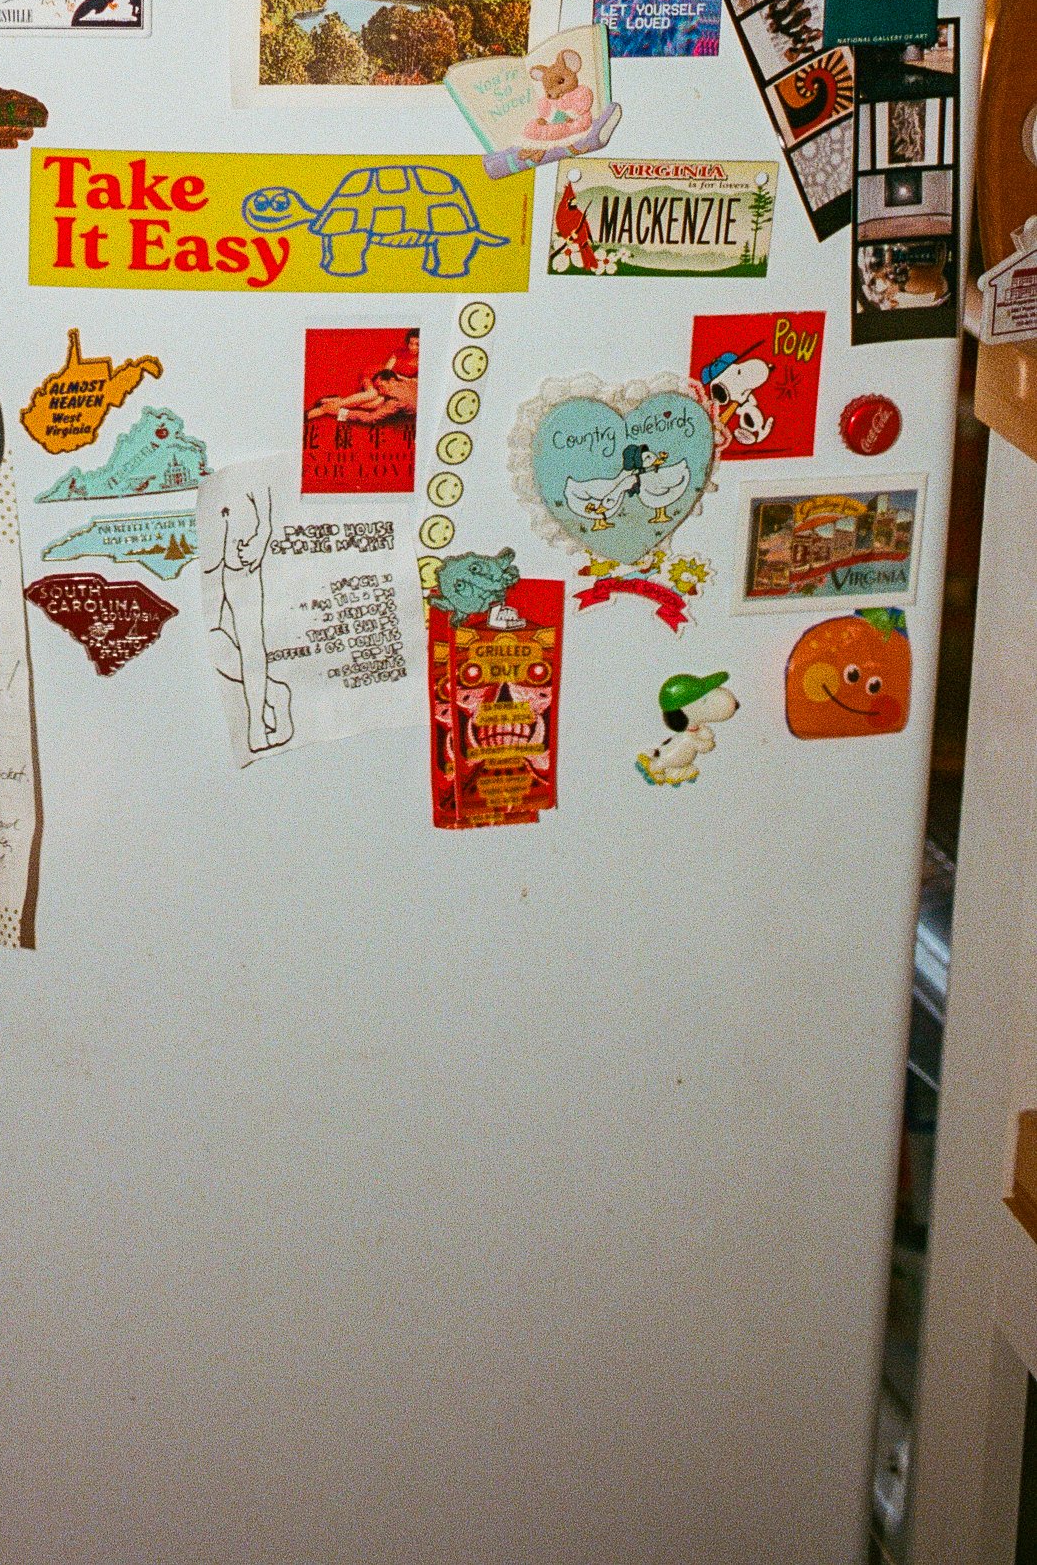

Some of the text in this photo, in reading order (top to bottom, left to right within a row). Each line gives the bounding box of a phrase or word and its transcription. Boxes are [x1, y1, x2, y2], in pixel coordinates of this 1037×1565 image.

[600, 3, 706, 17] LET YOURSELF
[600, 17, 671, 30] BE LOVED
[837, 36, 871, 45] NATIONAL
[873, 34, 903, 43] GALLERY
[915, 33, 928, 41] ART
[609, 161, 727, 181] VIRGINIA
[43, 156, 210, 213] Take
[599, 195, 741, 245] MACKENZIE
[53, 216, 291, 288] It Easy
[773, 318, 818, 363] POW
[49, 379, 106, 395] ALMOST
[48, 394, 106, 411] HEAVEN
[52, 412, 83, 424] West
[45, 424, 93, 439] Virginia
[552, 407, 696, 458] Country Lovebirds
[343, 521, 394, 537] HOUSE
[270, 535, 395, 555] SPRING MARKET
[330, 575, 379, 594] MARCH
[830, 568, 907, 590] VIRGINIA
[39, 586, 101, 599] SOUTH
[373, 587, 395, 602] PM
[47, 600, 141, 614] CAROLINA
[337, 598, 397, 623] VENDORS
[305, 623, 350, 643] THREE
[266, 645, 311, 663] COFFEE
[347, 627, 402, 649] DONUTS
[474, 645, 533, 657] GRILLED
[328, 654, 406, 679] DISCOUNTS
[489, 664, 521, 677] OUT
